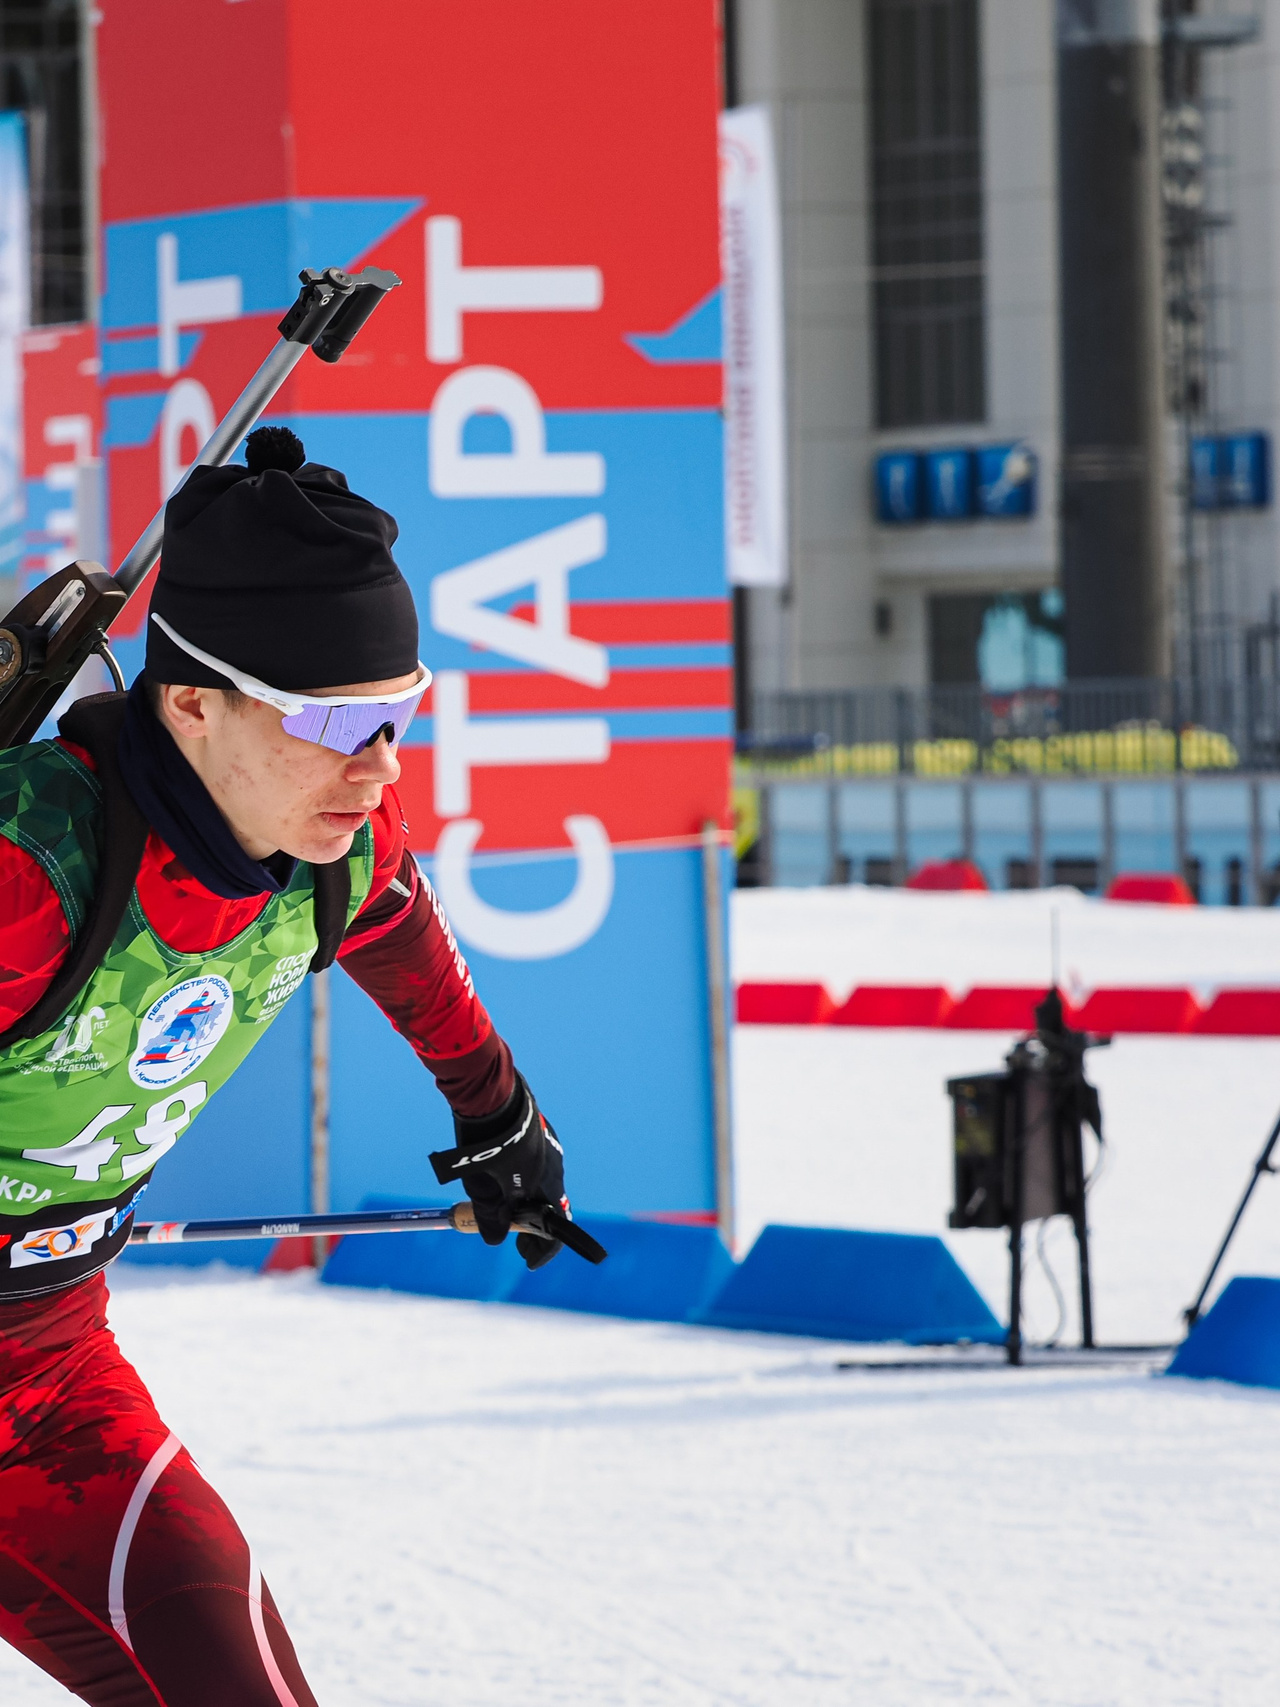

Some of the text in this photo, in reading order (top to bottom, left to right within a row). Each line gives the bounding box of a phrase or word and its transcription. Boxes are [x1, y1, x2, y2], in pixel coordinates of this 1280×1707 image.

[423, 213, 616, 962] СТАРТ
[147, 977, 230, 1021] ПЕРВЕНСТВО РОССИИ
[93, 1019, 110, 1030] ЛЕТ
[20, 1080, 208, 1182] 49
[512, 1173, 522, 1188] LEFT
[260, 1222, 301, 1235] NANOLITE
